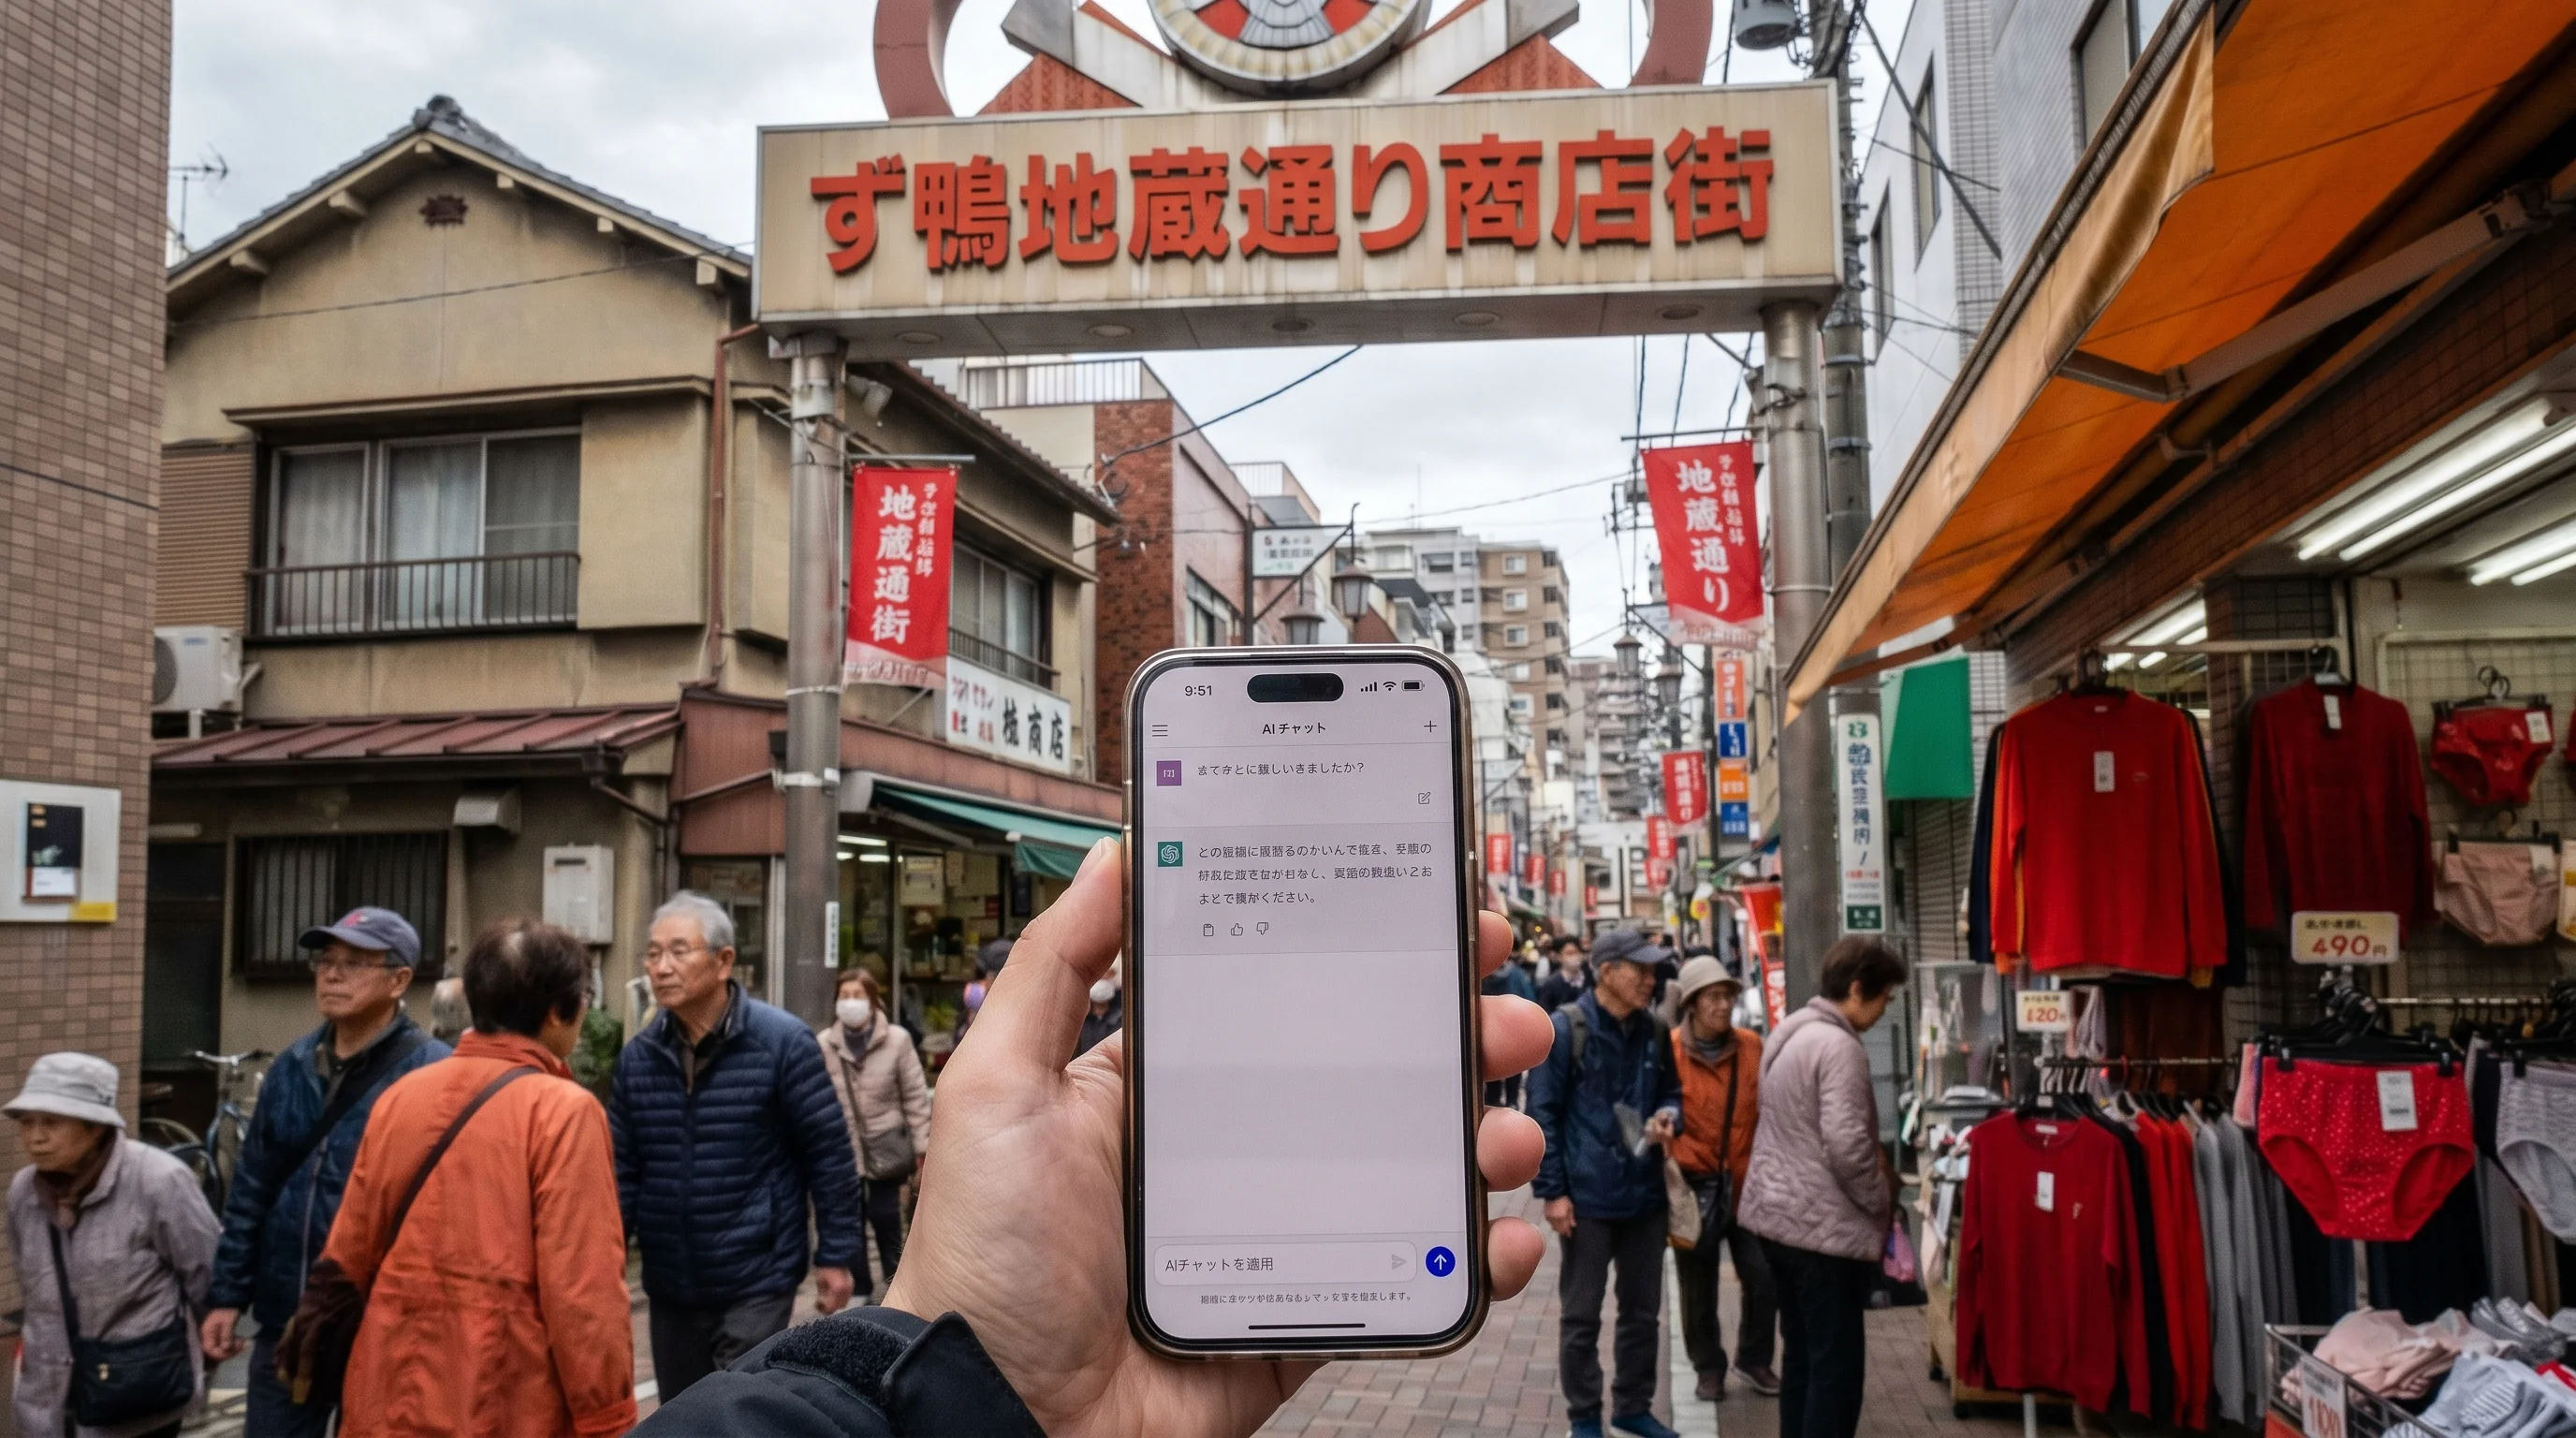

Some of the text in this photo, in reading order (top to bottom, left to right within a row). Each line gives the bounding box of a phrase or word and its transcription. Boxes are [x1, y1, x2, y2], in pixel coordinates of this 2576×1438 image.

[811, 127, 1775, 275] ず鴨地蔵通り商店街
[870, 484, 916, 645] 地蔵通街
[1676, 458, 1731, 612] 地蔵通り
[1184, 684, 1213, 697] 9:51
